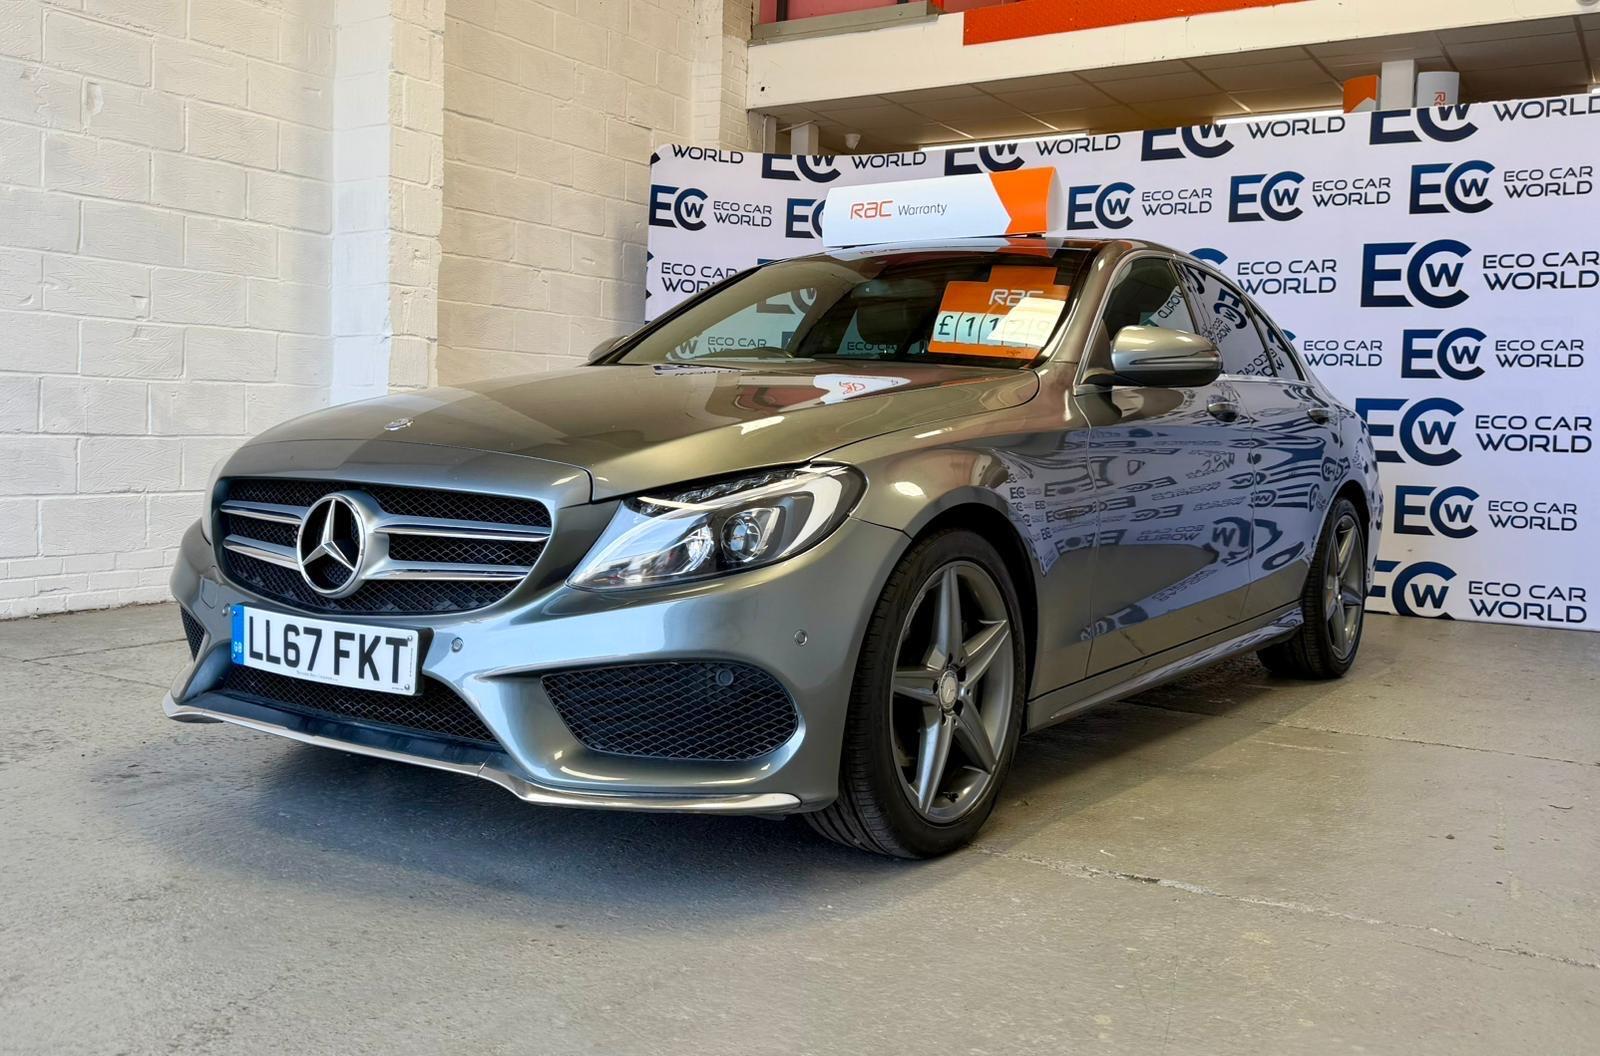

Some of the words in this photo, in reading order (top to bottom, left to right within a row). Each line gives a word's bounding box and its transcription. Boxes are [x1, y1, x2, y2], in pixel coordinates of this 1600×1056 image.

[1246, 116, 1345, 139] WORLD
[1035, 134, 1121, 156] WORLD
[672, 144, 744, 164] WORLD
[851, 151, 927, 169] WORLD
[1504, 169, 1544, 182] ECO
[1549, 166, 1593, 179] CAR
[1312, 178, 1348, 192] ECO
[1353, 176, 1391, 190] CAR
[1504, 181, 1593, 198] WORLD
[1141, 190, 1174, 202] ECO
[1177, 188, 1213, 199] CAR
[1312, 190, 1391, 208] WORLD
[713, 201, 740, 212] ECO
[743, 203, 772, 215] CAR
[898, 202, 948, 217] Warranty
[1141, 201, 1213, 216] WORLD
[713, 212, 772, 227] WORLD
[1237, 261, 1282, 276] ECO
[1288, 259, 1337, 273] CAR
[1483, 253, 1535, 269] ECO
[1542, 251, 1600, 267] CAR
[661, 262, 696, 277] ECO
[661, 277, 714, 293] WOR
[1237, 276, 1337, 295] WORLD
[1483, 270, 1600, 291] WORLD
[707, 336, 735, 346] ECO
[737, 337, 767, 347] CAR
[1304, 340, 1338, 351] ECO
[1343, 340, 1383, 351] CAR
[1495, 340, 1535, 351] ECO
[1540, 340, 1584, 351] CAR
[1304, 353, 1383, 367] WORLD
[1495, 353, 1584, 368] WORLD
[1475, 415, 1528, 430] ECO
[1535, 416, 1592, 431] CAR
[1475, 433, 1592, 453] WORLD
[1488, 500, 1528, 513] ECO
[1533, 502, 1578, 515] CAR
[1488, 514, 1578, 531] WORLD
[1468, 580, 1521, 598] ECO
[1529, 585, 1587, 602] CAR
[1469, 599, 1587, 624] WORLD
[249, 616, 322, 672] LL67
[334, 630, 409, 684] FKT
